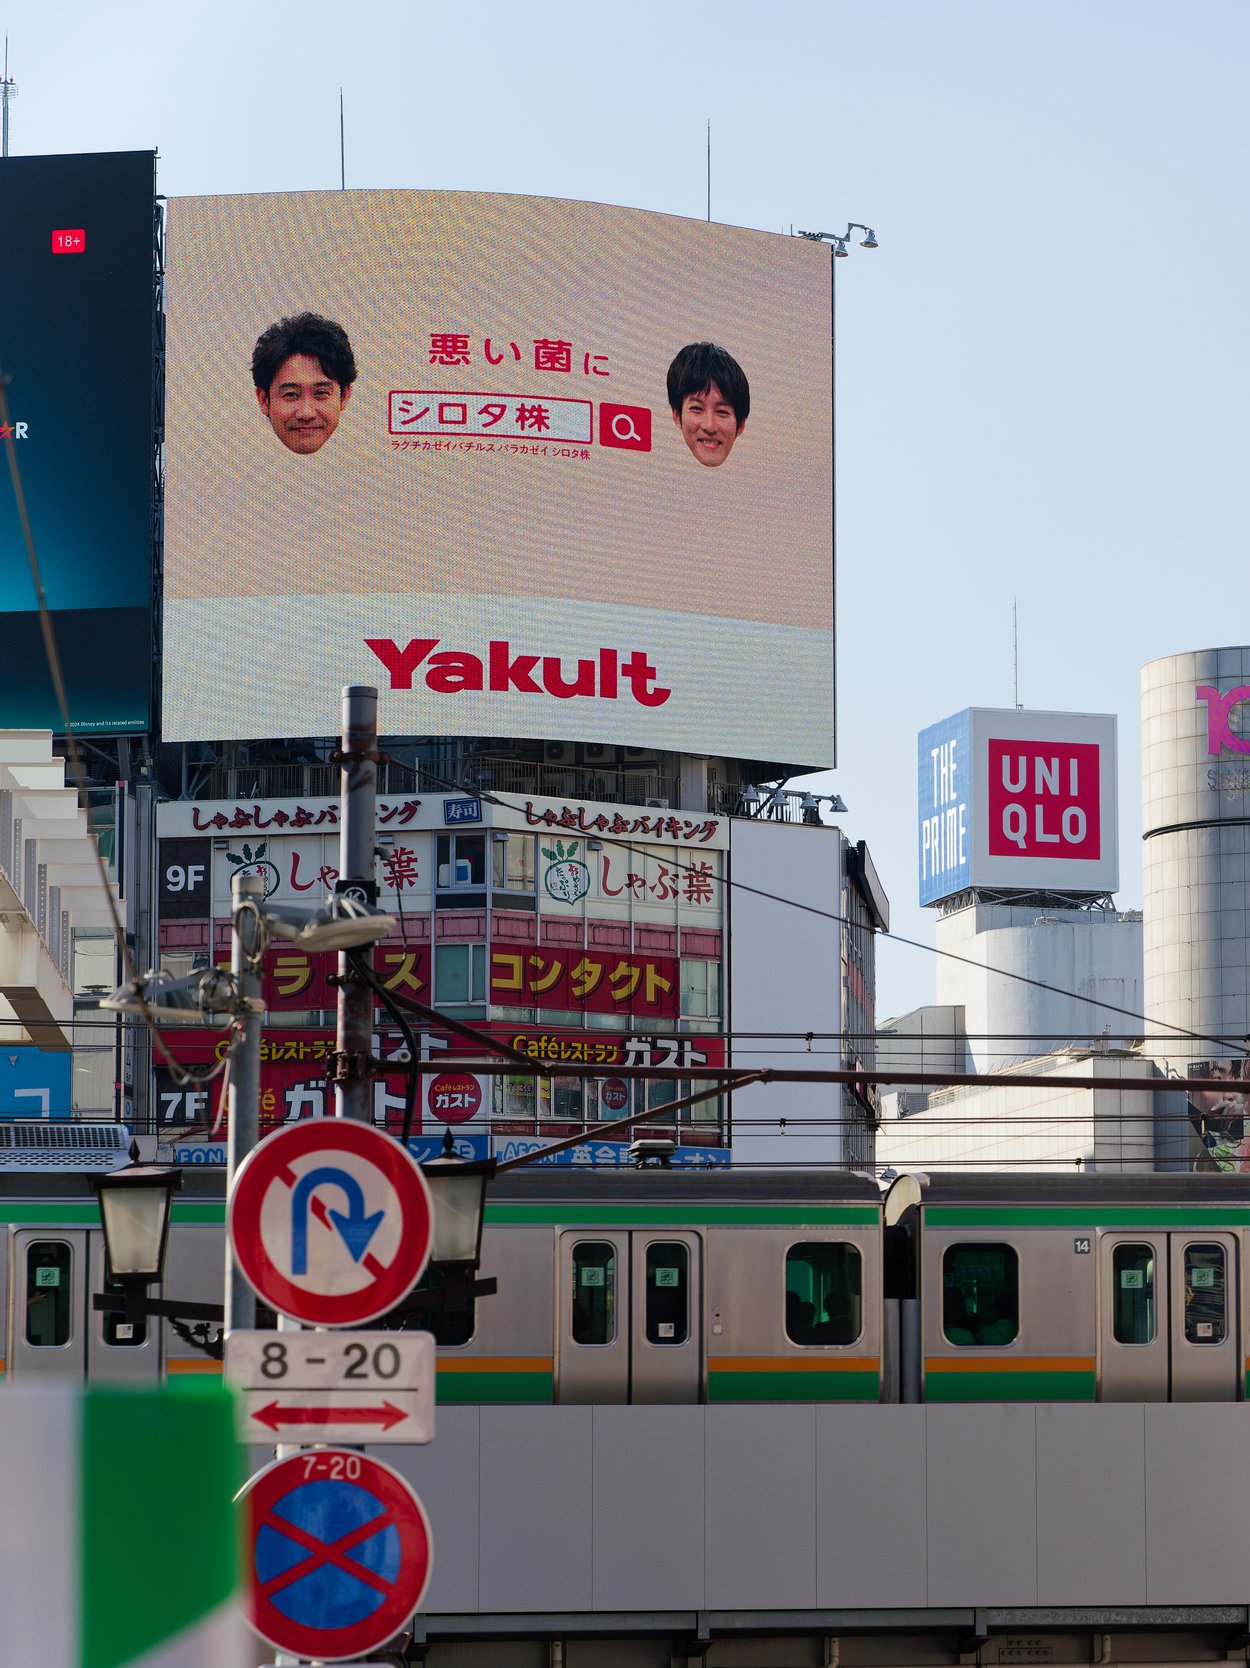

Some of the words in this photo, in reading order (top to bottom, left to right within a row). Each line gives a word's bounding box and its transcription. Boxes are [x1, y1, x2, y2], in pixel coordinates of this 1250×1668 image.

[58, 235, 80, 247] 18+
[429, 333, 610, 377] 悪い菌に
[398, 400, 550, 433] シロタ株
[552, 447, 591, 461] シロタ株
[364, 639, 671, 707] Yakult
[931, 739, 957, 809] THE
[1002, 755, 1079, 797] UNI
[192, 800, 422, 831] しゃぶしゃぶバング
[447, 802, 479, 819] 寿司
[526, 801, 720, 844] しゃぶしゃぶバイキング
[1002, 803, 1087, 849] QLO
[922, 803, 966, 881] PRIME
[166, 864, 206, 893] 9F
[290, 846, 420, 891] しゃ葉
[602, 855, 715, 906] しゃぶ葉
[492, 953, 672, 1003] コンタクト
[625, 1036, 707, 1068] ガスト
[160, 1091, 209, 1123] 7F
[285, 1080, 407, 1130] ガト
[435, 1094, 477, 1109] ガスト
[1075, 1240, 1090, 1253] 14
[302, 1455, 361, 1480] 7-20
